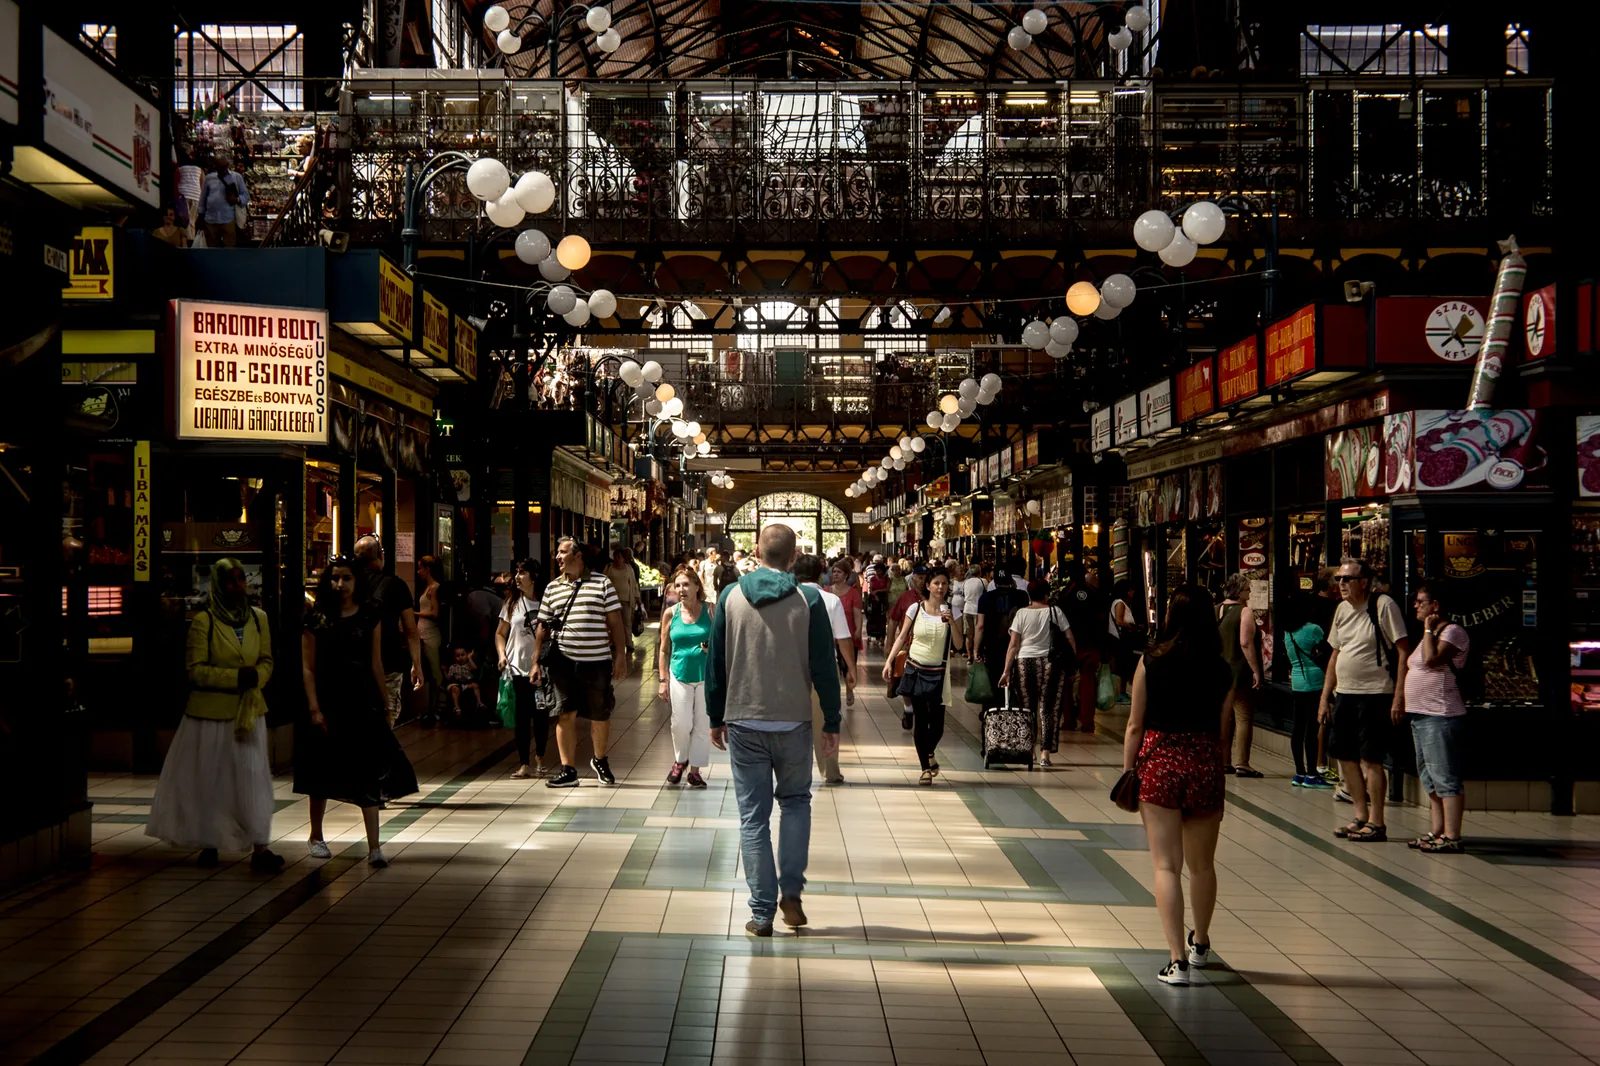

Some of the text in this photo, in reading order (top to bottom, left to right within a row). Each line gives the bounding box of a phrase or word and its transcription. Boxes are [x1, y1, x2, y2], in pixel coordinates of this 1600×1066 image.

[1435, 303, 1475, 317] SZABÓ
[194, 312, 316, 341] BAROMFI BOLT
[195, 341, 313, 360] EXTRA MINŐSÉGŰ
[195, 386, 253, 402] EGÉSZBE
[264, 391, 313, 405] BONTVA
[194, 406, 315, 433] LIBAMÁJ GÄNSELEBER
[1495, 467, 1518, 479] PICK
[1448, 595, 1515, 628] ELEBER
